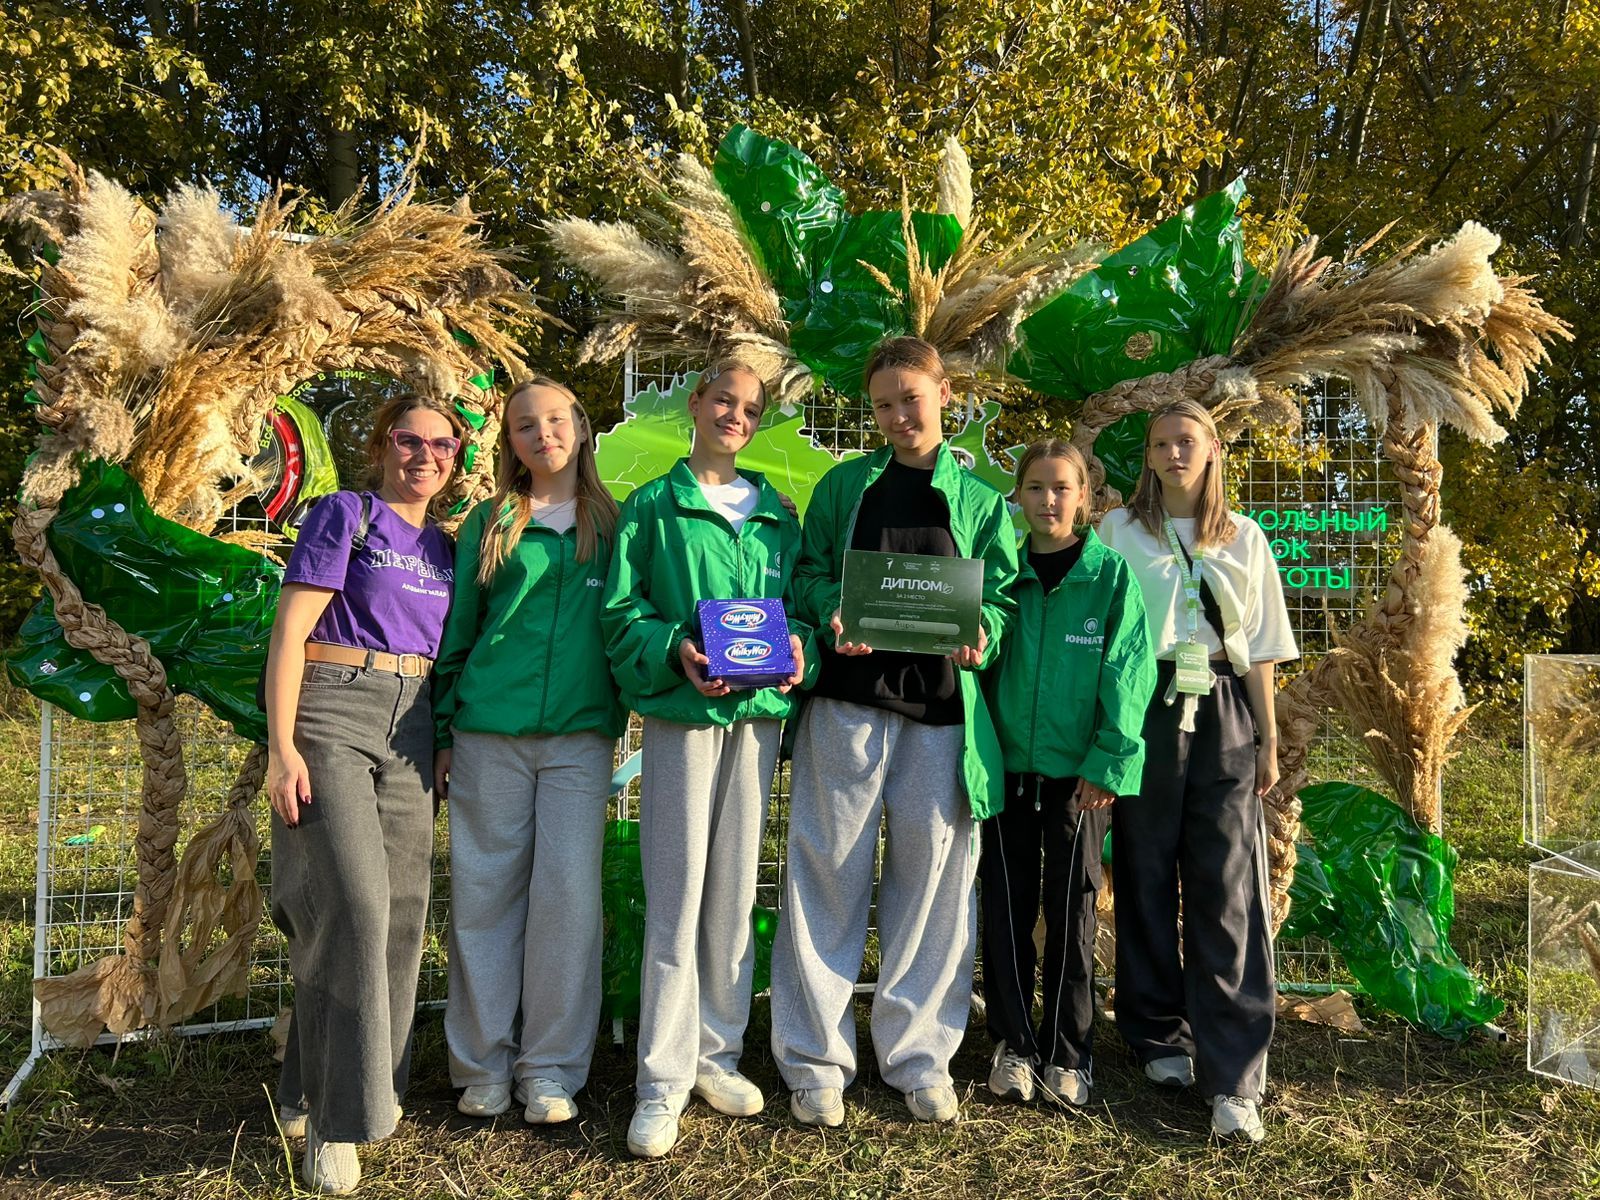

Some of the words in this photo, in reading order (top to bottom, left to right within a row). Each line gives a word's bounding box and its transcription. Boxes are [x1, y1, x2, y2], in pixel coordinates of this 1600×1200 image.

[260, 424, 274, 449] Вся
[317, 372, 326, 382] в
[880, 577, 943, 592] ДИПЛОМ
